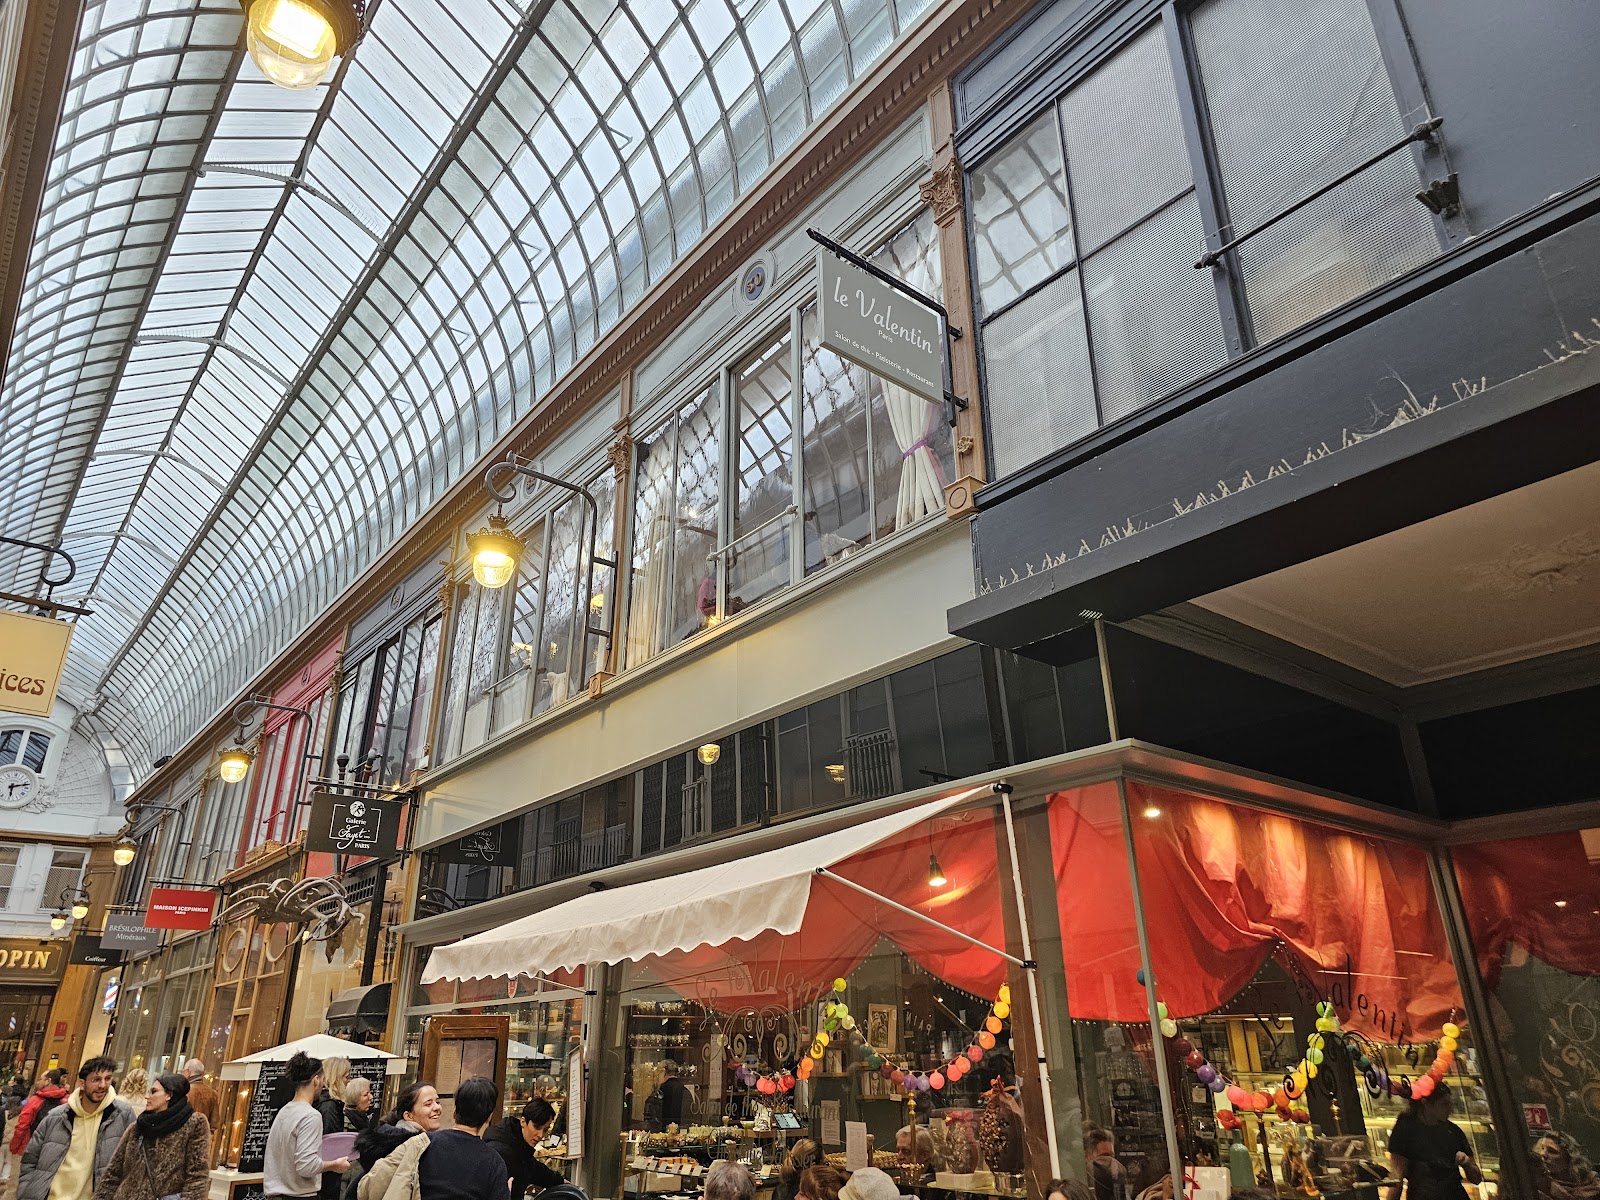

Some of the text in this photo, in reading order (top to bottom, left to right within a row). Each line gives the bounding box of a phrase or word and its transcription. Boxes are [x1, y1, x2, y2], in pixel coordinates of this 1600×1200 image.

[855, 289, 933, 354] Valentin
[878, 329, 894, 343] Paris
[834, 330, 851, 344] Salon
[852, 341, 860, 349] de
[906, 367, 935, 388] Restaurant
[345, 817, 367, 825] Galerie
[108, 923, 157, 934] BRÉSILOPHILE
[115, 933, 147, 941] Minéraux
[84, 955, 107, 963] Coiffeur
